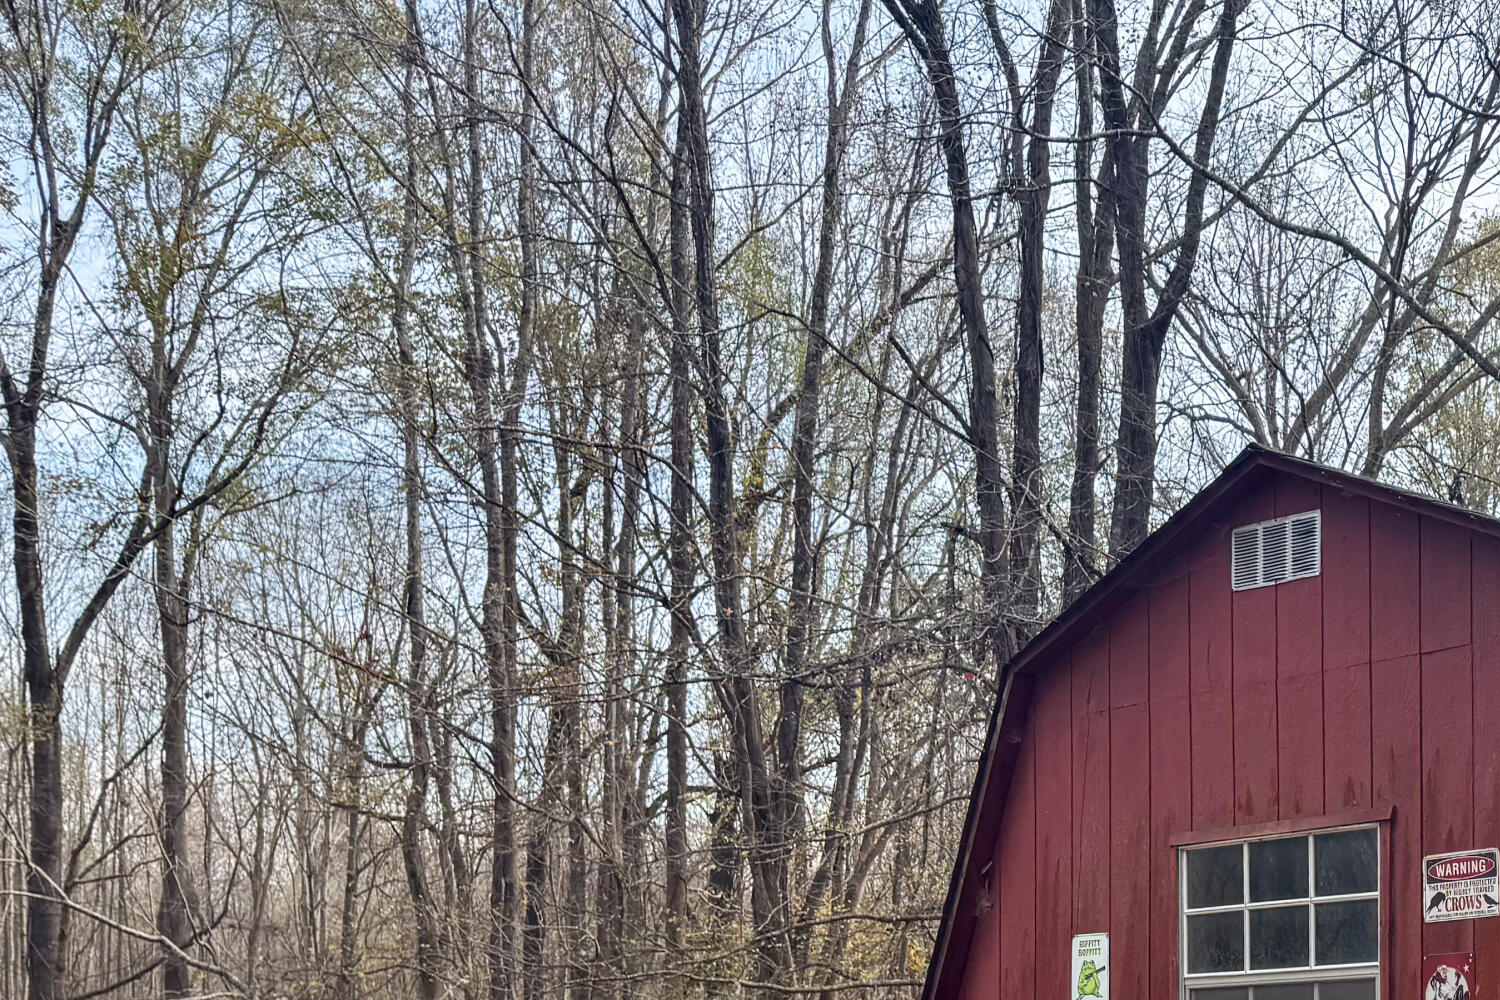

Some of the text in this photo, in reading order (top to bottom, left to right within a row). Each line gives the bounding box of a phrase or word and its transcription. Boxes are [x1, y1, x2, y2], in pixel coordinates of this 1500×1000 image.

[1435, 859, 1486, 877] WARNING
[1429, 884, 1439, 892] THIS
[1440, 882, 1463, 891] PROPERTY
[1469, 878, 1496, 887] PROTECTED
[1445, 894, 1482, 912] CROWS
